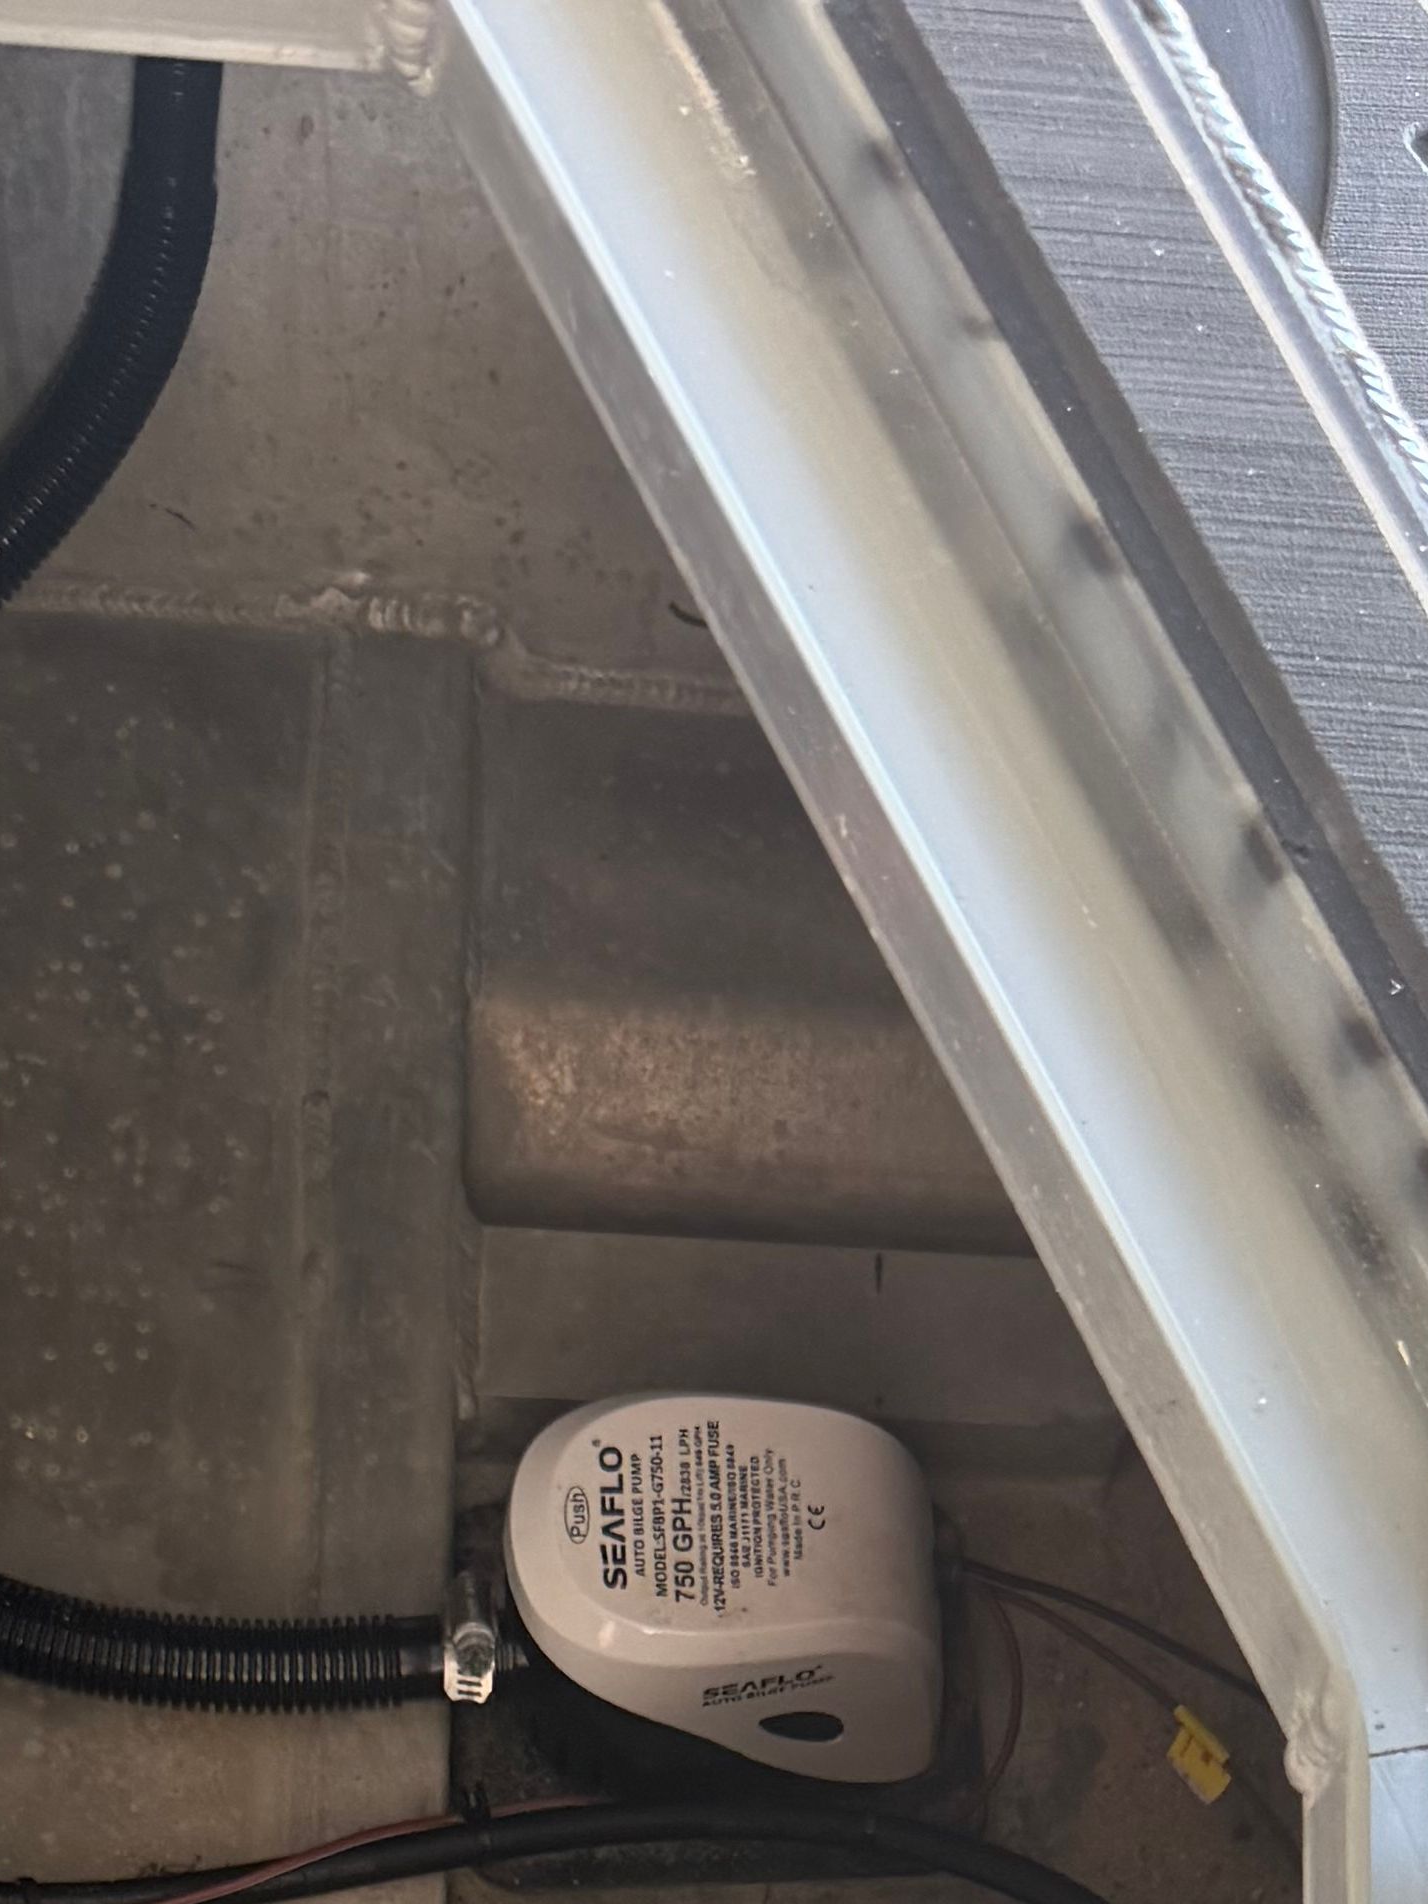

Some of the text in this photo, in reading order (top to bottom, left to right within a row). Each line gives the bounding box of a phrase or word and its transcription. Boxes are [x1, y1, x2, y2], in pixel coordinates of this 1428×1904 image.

[678, 1428, 690, 1456] LPH
[706, 1420, 720, 1457] FUSE
[708, 1460, 721, 1491] AMP
[738, 1465, 749, 1509] MARINE
[750, 1455, 762, 1525] PROTECTED
[570, 1492, 587, 1538] Push
[598, 1445, 628, 1590] SEAFLO
[629, 1453, 646, 1577] AUTO BILGE PUMP
[674, 1561, 695, 1602] 750
[710, 1513, 726, 1612] 12V-REQUIRES
